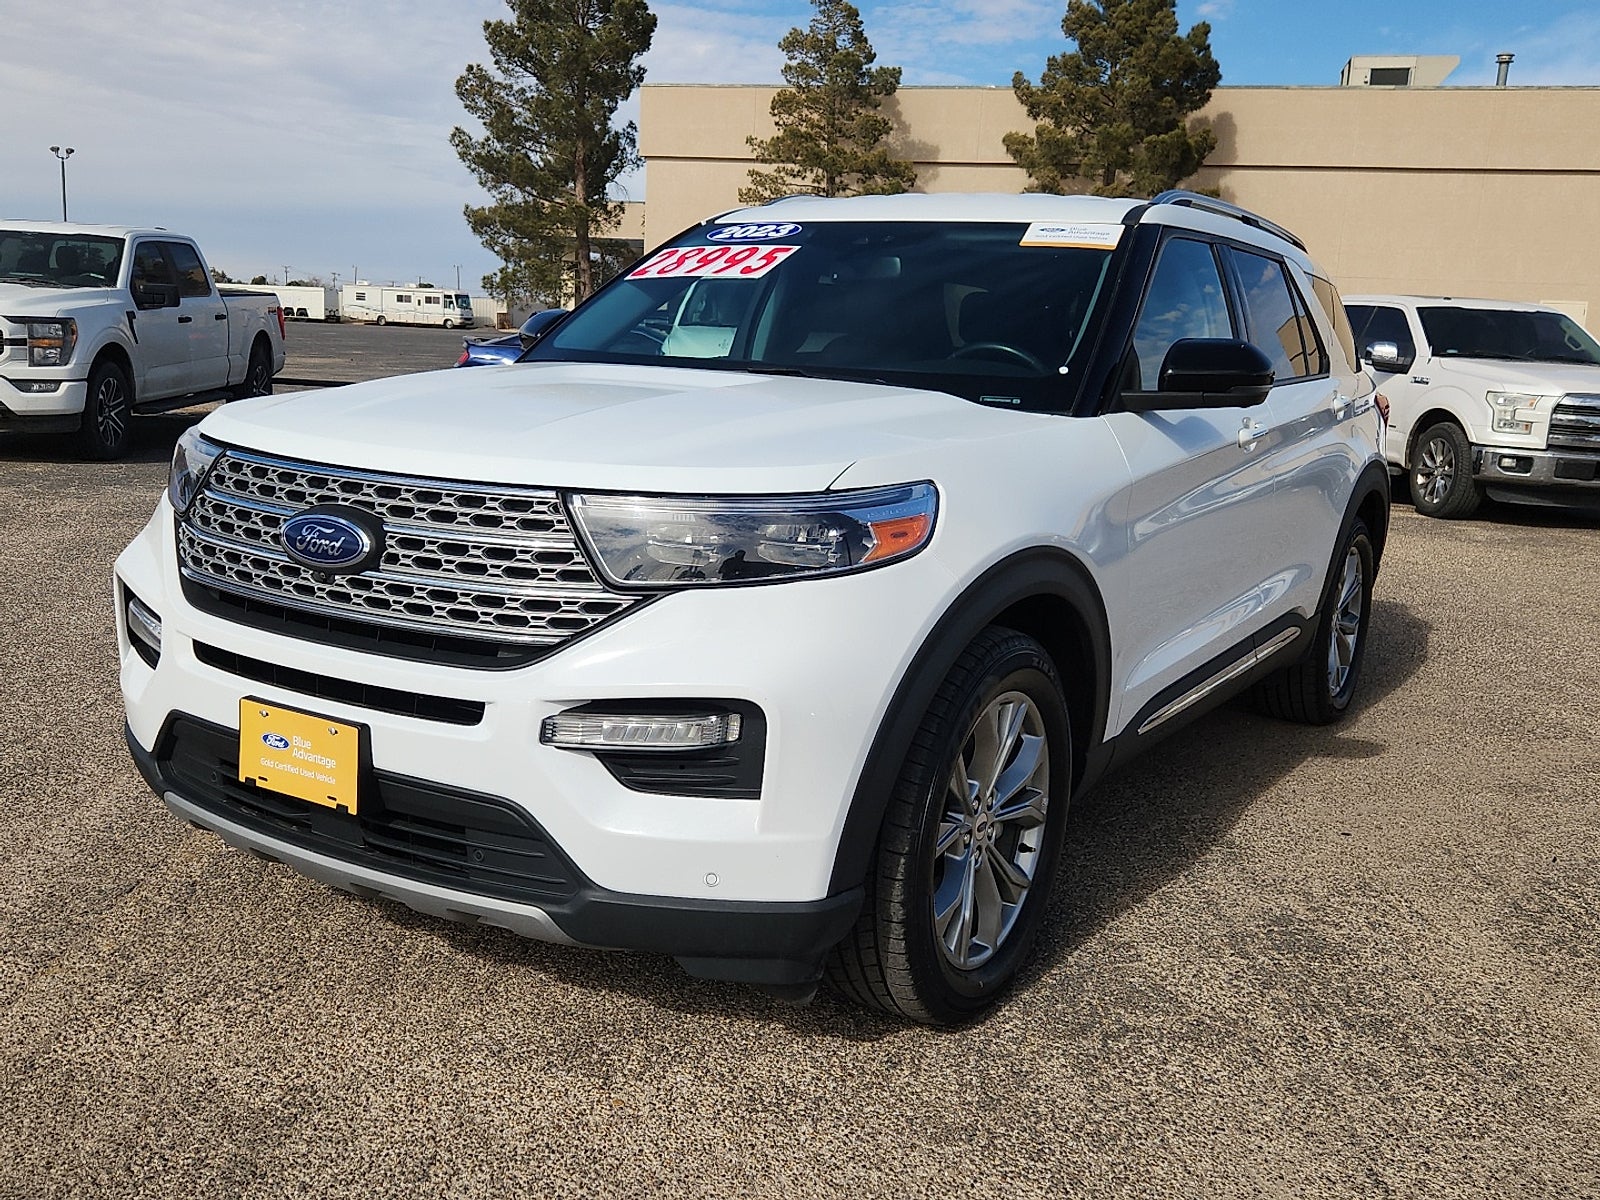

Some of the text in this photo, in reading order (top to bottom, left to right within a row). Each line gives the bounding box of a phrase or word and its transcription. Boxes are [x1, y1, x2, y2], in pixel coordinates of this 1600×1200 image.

[713, 224, 795, 239] 2023
[630, 247, 794, 276] 28995
[296, 524, 345, 556] Ford
[266, 734, 285, 748] Ford
[293, 736, 311, 749] Blue
[292, 748, 336, 768] Advantage
[260, 757, 336, 784] Gold Certified Used Vehicle
